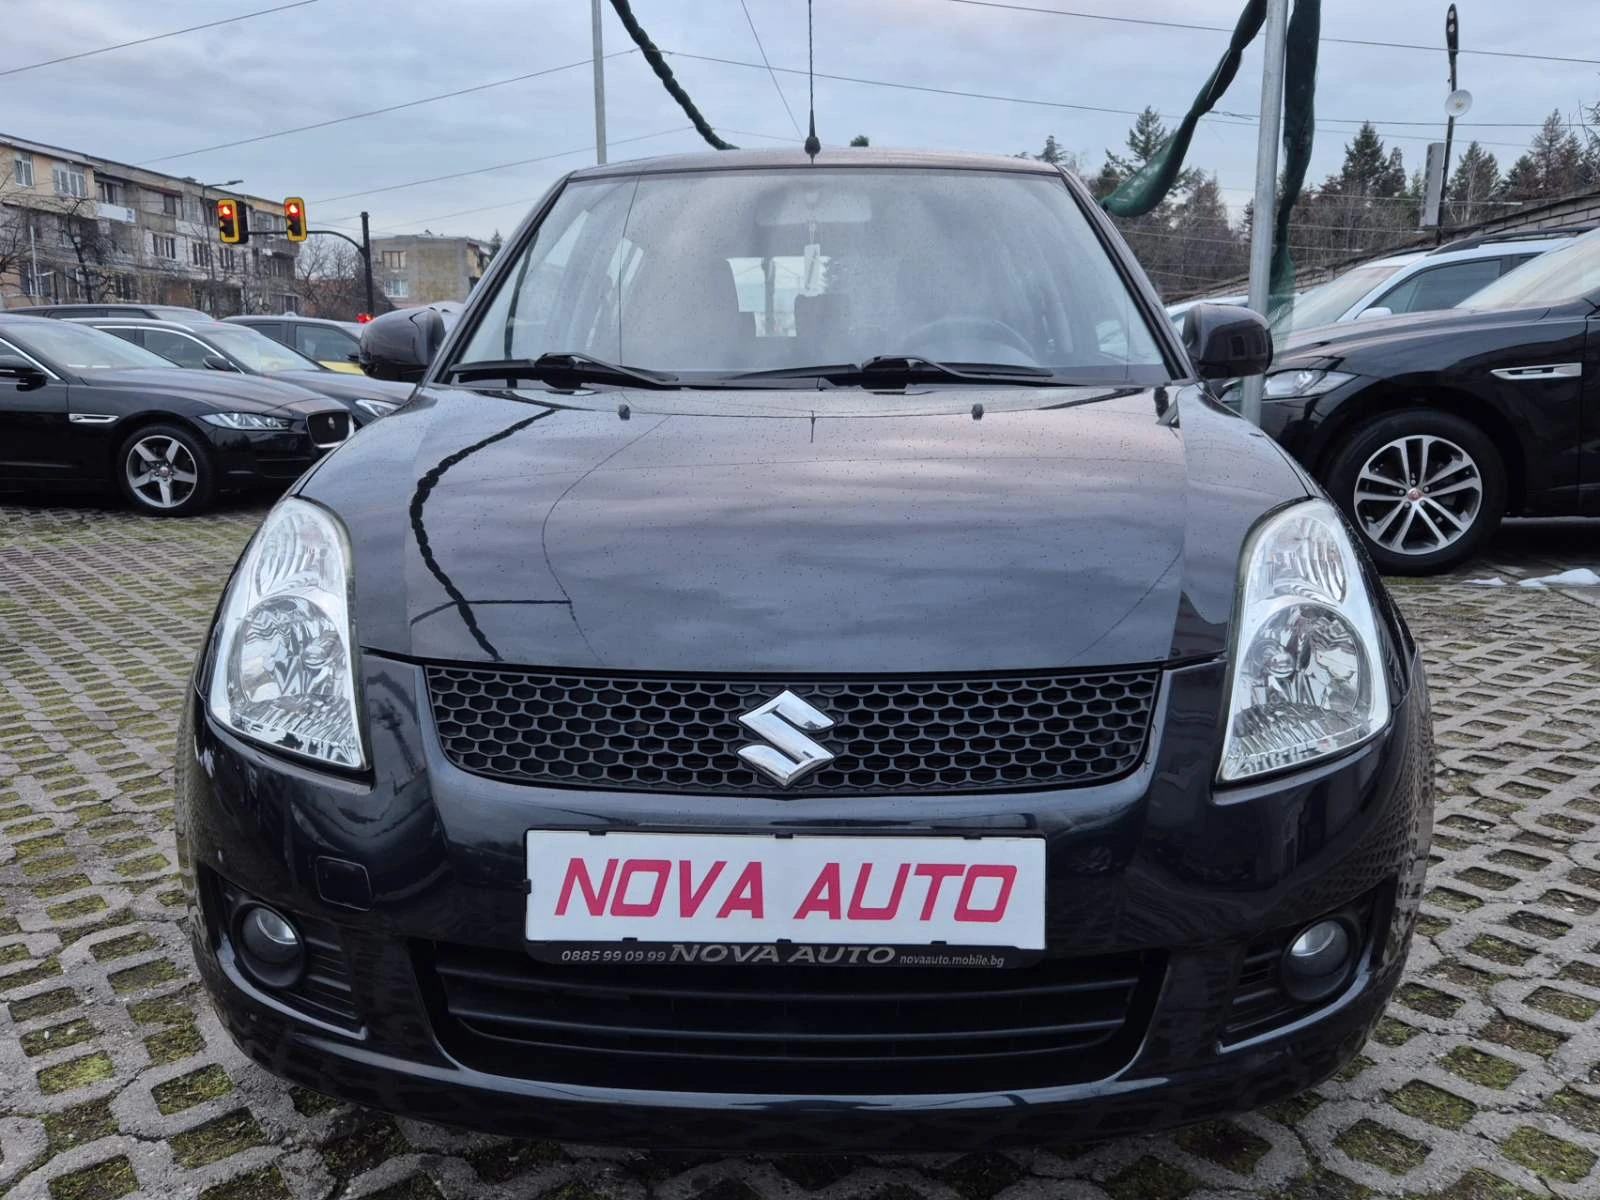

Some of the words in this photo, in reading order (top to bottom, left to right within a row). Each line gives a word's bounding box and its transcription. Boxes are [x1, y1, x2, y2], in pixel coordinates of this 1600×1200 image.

[554, 857, 765, 919] NOVA
[793, 862, 1018, 922] AUTO
[561, 950, 600, 962] 0885
[602, 950, 621, 962] 99
[624, 950, 644, 962] 09
[647, 951, 666, 963] 99
[669, 944, 780, 963] NOVA
[787, 946, 897, 965] AUTO
[900, 954, 1005, 969] novaauto.mobile.bg
